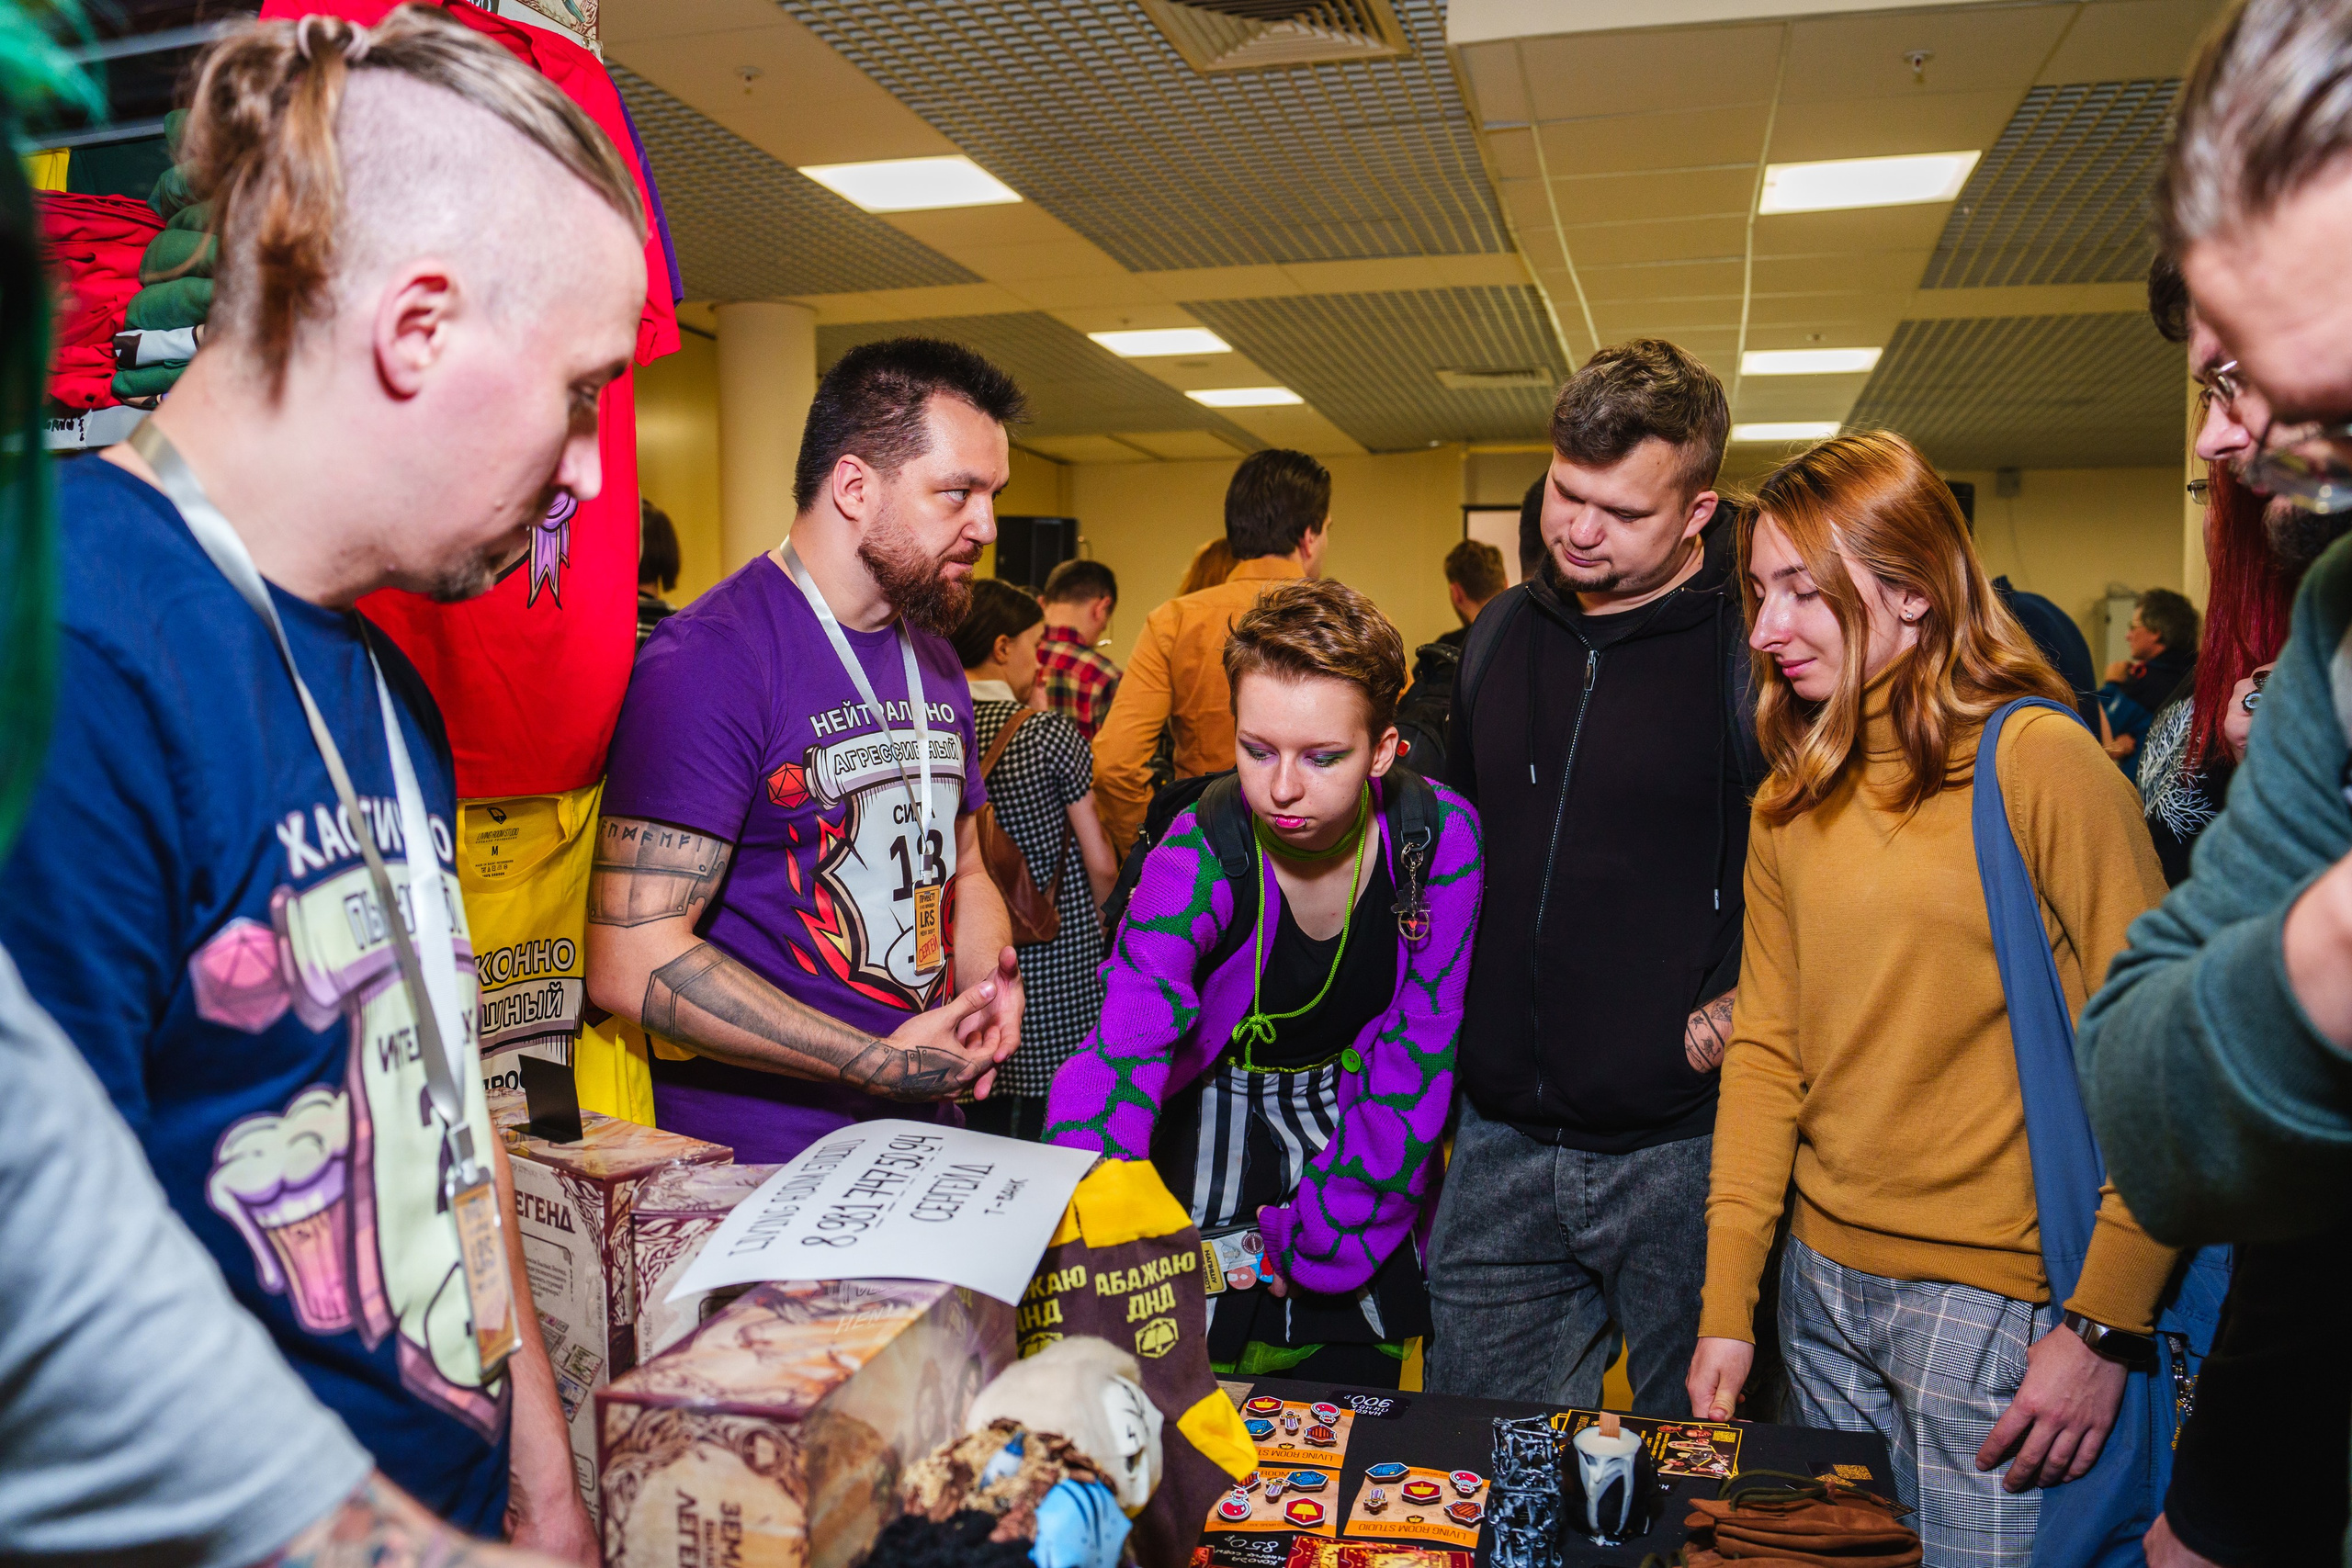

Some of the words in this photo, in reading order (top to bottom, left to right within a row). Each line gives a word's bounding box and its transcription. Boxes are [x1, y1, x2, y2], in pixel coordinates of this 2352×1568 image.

[809, 700, 956, 738] НЕЙТАЛНО
[920, 909, 935, 928] LRS
[1094, 1250, 1196, 1297] АБАЖАЮ
[1126, 1281, 1177, 1324] ДНД
[1272, 1450, 1299, 1459] ROOM
[1302, 1451, 1333, 1461] LIVING
[1358, 1523, 1400, 1532] STUDIO
[1403, 1526, 1430, 1535] ROOM
[1431, 1528, 1467, 1540] LIVING
